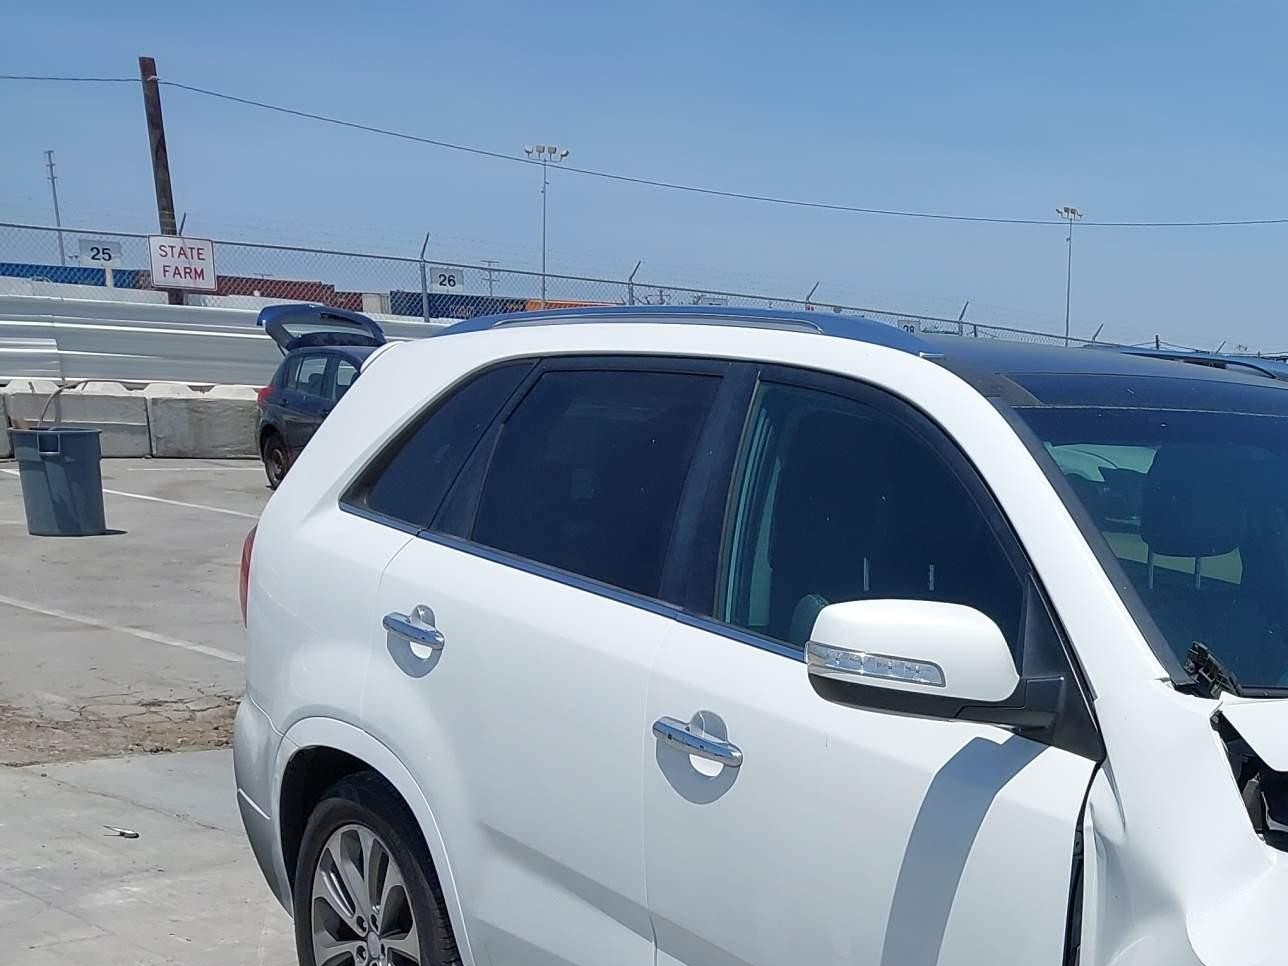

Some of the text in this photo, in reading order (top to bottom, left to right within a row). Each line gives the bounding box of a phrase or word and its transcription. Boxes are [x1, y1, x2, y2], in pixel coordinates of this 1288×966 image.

[90, 246, 112, 261] 25
[158, 244, 206, 261] STATE
[162, 265, 205, 281] FARM
[438, 273, 456, 288] 26
